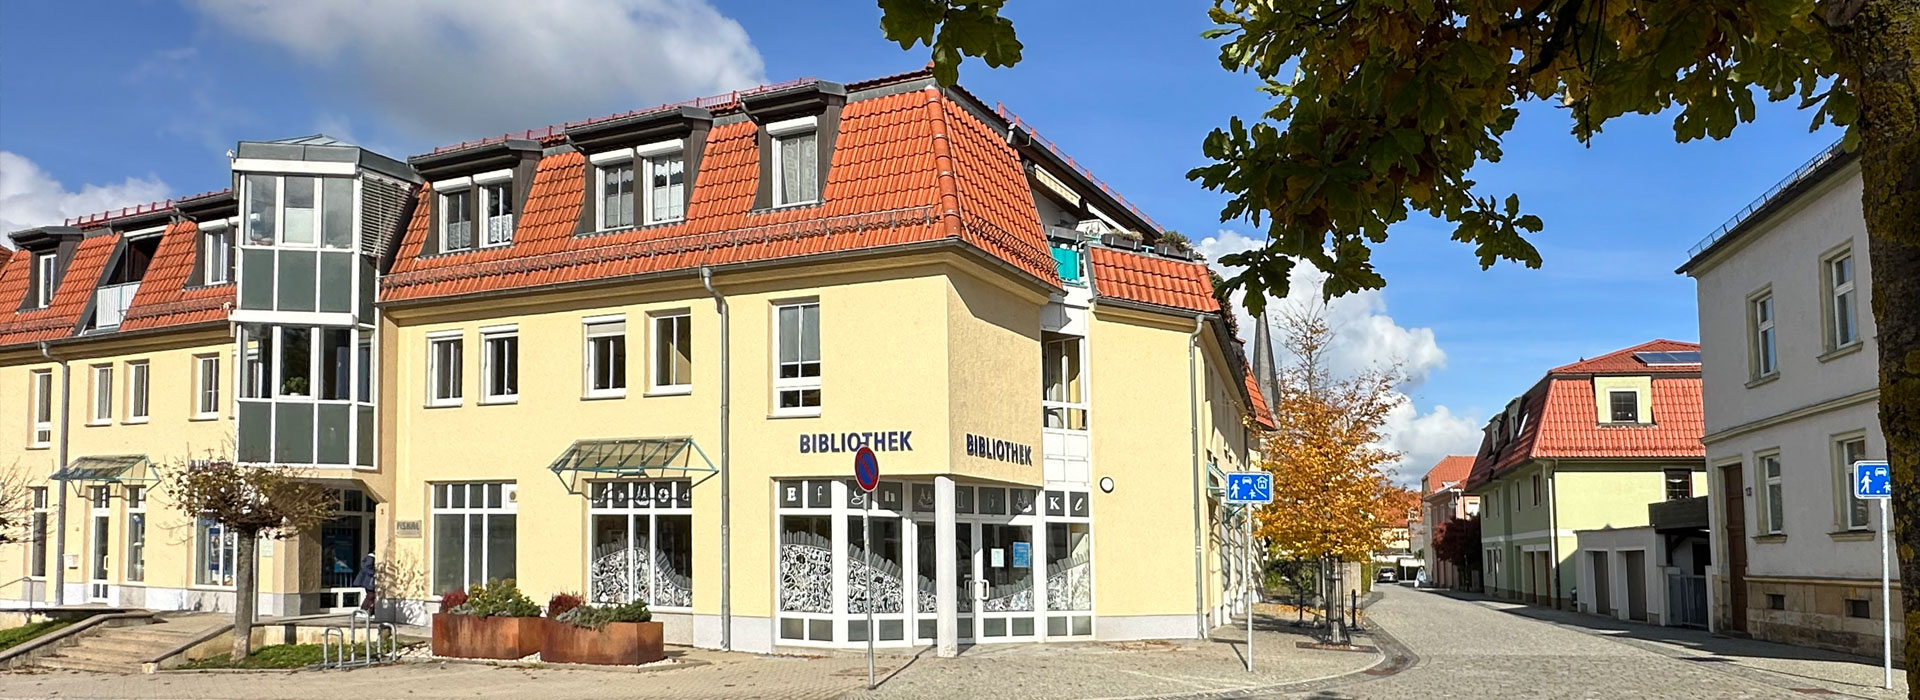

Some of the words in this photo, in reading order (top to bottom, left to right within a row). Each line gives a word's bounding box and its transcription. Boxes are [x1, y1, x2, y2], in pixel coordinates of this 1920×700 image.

[800, 431, 913, 453] BIBLIOTHEK
[966, 433, 1032, 466] BIBLIOTHEK
[787, 487, 797, 501] E
[1049, 496, 1060, 510] K
